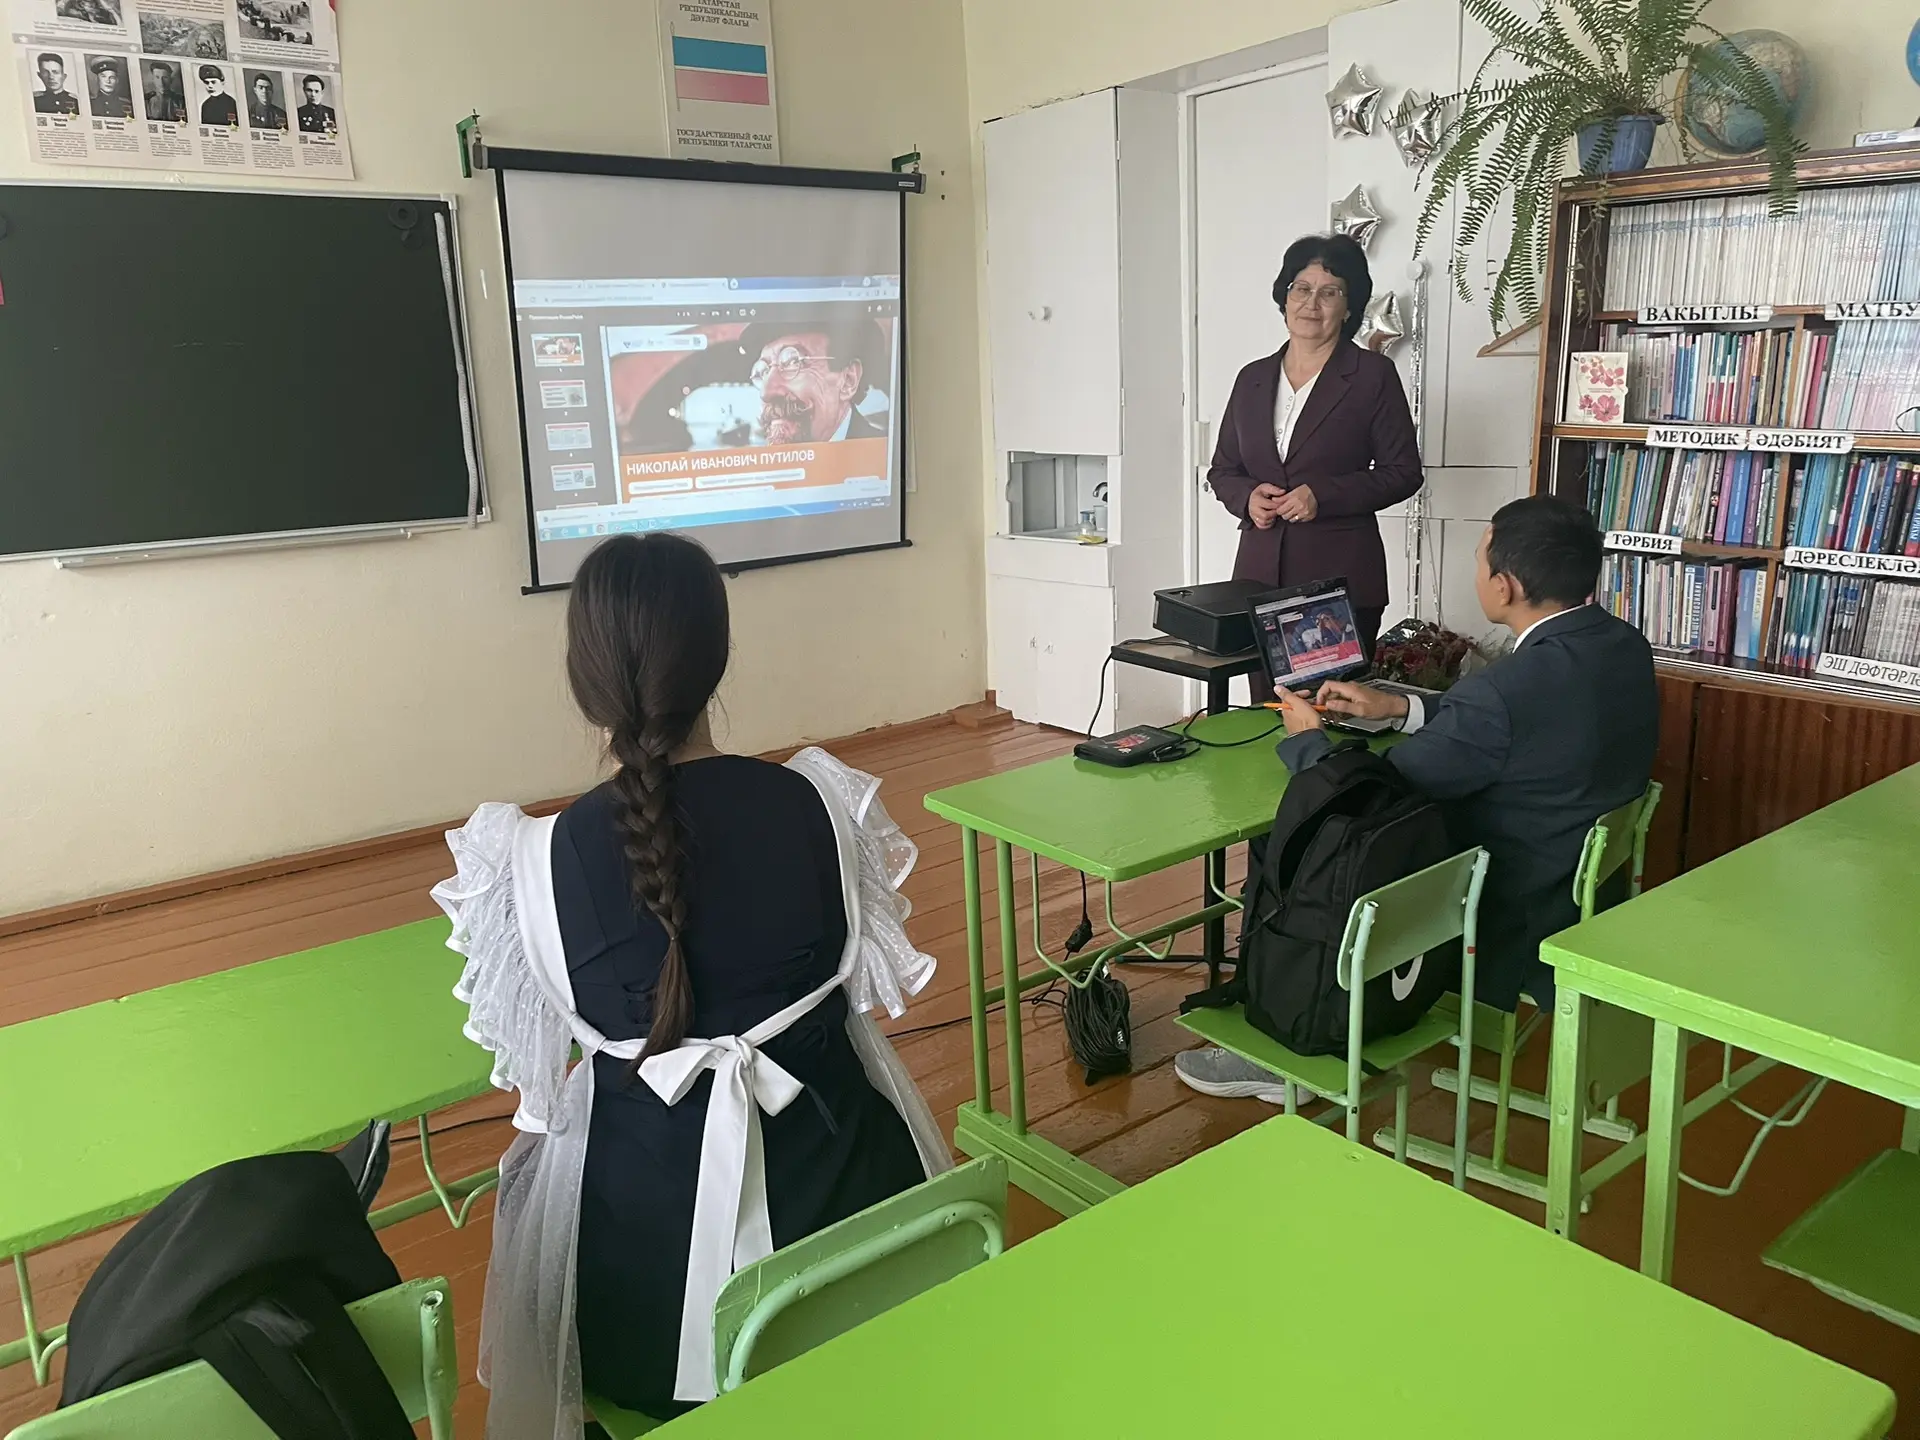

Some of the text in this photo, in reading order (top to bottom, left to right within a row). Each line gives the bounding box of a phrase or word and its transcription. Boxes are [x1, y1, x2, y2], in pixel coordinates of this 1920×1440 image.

[722, 18, 749, 27] ФЛАГЫ
[676, 128, 773, 142] ГОСУДАРСТВЕННЫЙ ФЛАГ
[678, 137, 773, 150] РЕСПУБЛИКИ ТАТАРСТАН
[1646, 304, 1760, 322] ВАКЫТЛЫ
[1834, 301, 1920, 318] МАТБУ
[1653, 430, 1846, 450] МЕТОДИК ӘДӘБИЯТ
[626, 449, 815, 476] НИКОЛАЙ ИВАНОВИЧ ПУТИЛОВ
[1612, 533, 1673, 551] ТӘРБИЯ
[1790, 550, 1920, 573] ДӘРЕСЛЕКЛӘ
[1823, 655, 1848, 671] ЭШ
